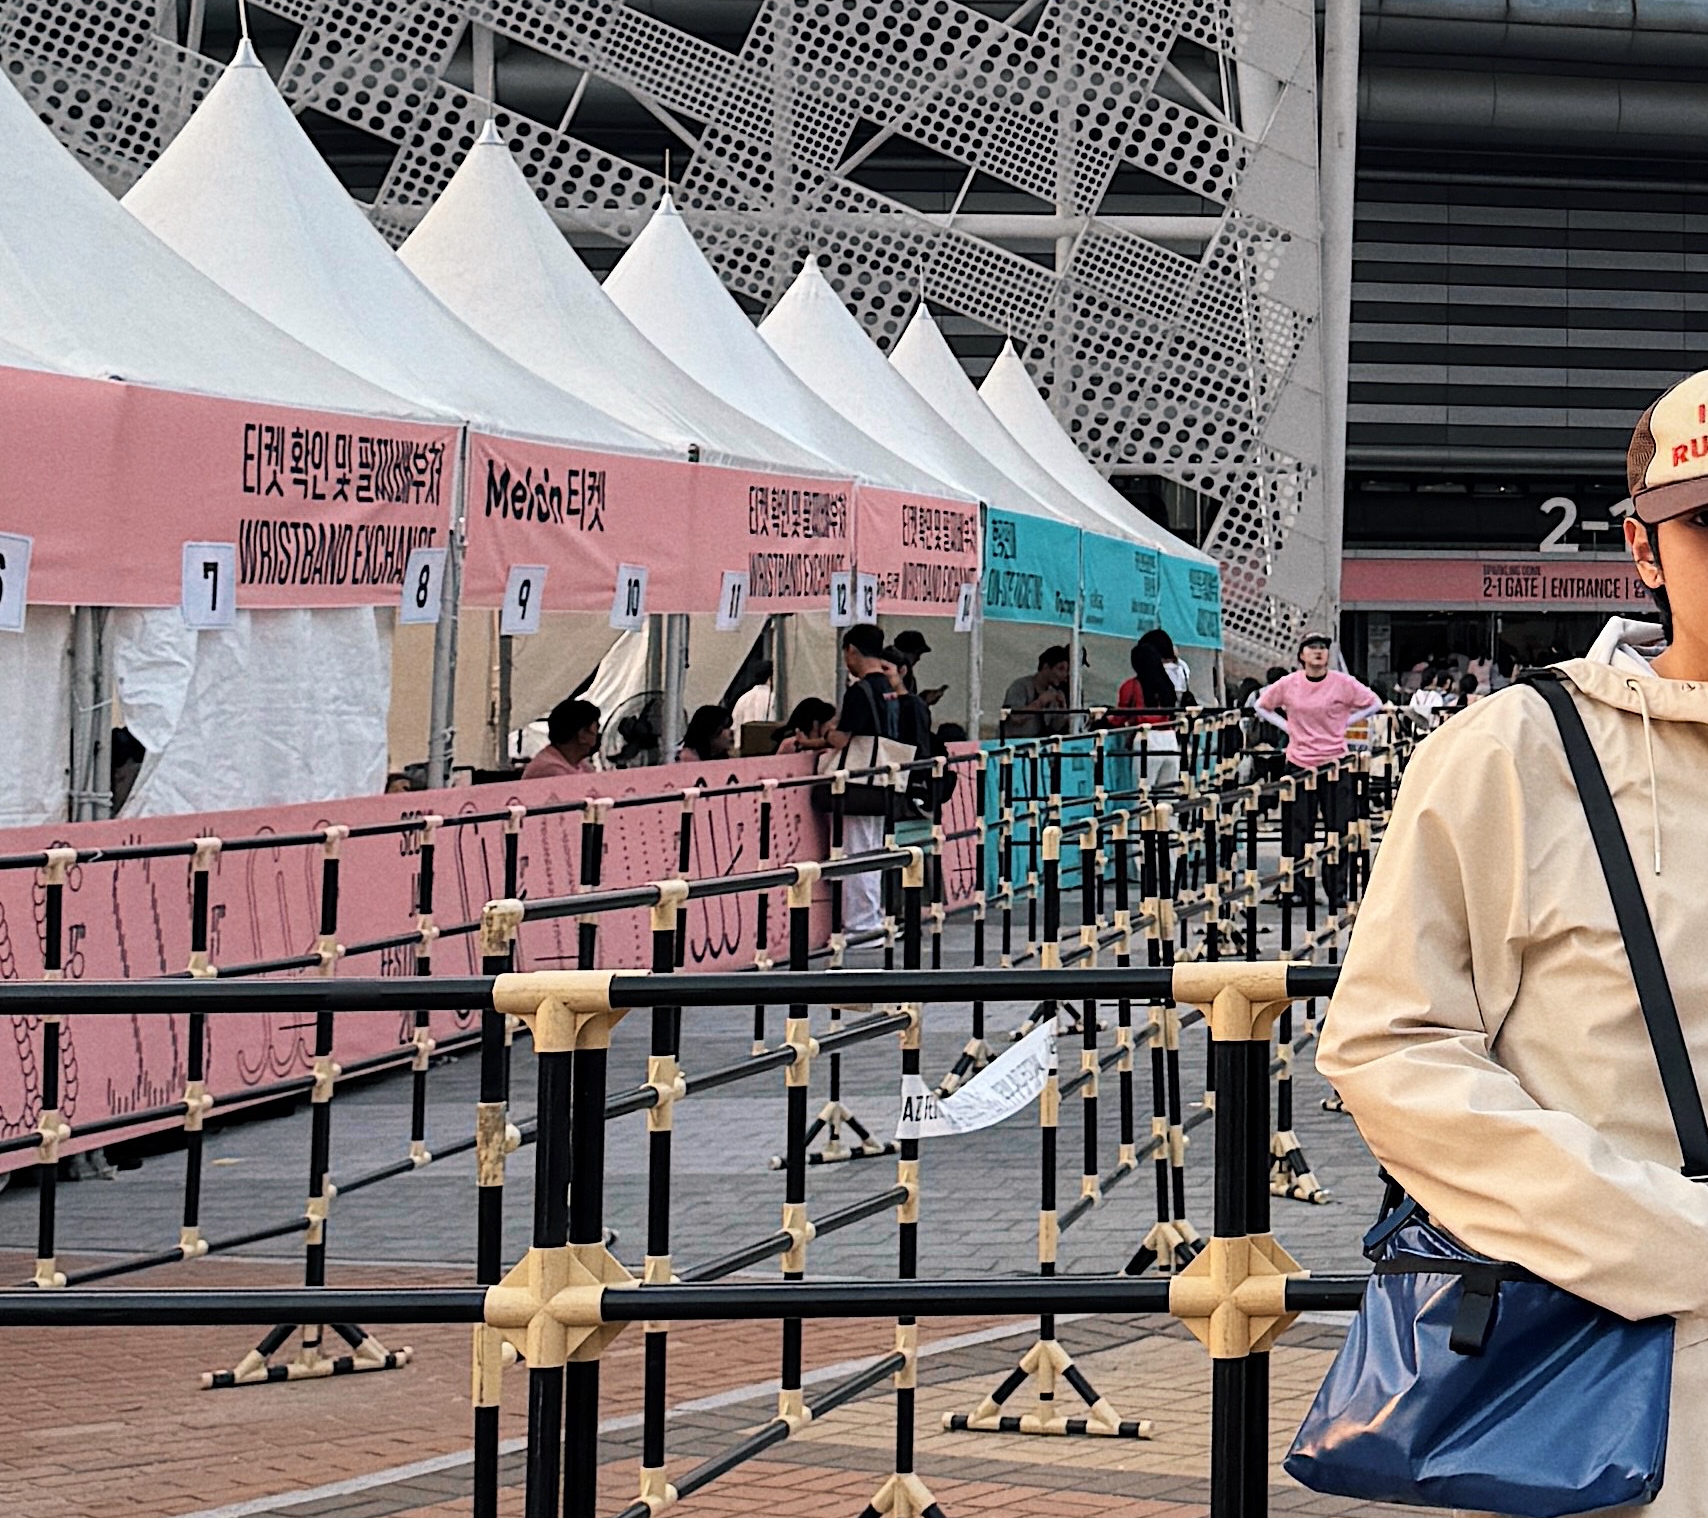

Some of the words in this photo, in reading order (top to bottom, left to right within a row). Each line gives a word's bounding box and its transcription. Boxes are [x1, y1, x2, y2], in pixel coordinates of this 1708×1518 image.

[1698, 403, 1706, 423] I
[243, 423, 285, 497] 티켓
[290, 427, 329, 501] 확인
[332, 433, 353, 502] 및
[239, 519, 353, 586] WRISTBAND
[203, 562, 219, 611] 7
[416, 564, 430, 608] 8
[518, 579, 531, 620] 9
[626, 578, 640, 617] 10
[729, 583, 741, 618] 11
[837, 583, 847, 615] 12
[1483, 577, 1502, 597] 2-1
[1506, 577, 1538, 598] GATE
[1551, 578, 1620, 599] ENTRANCE
